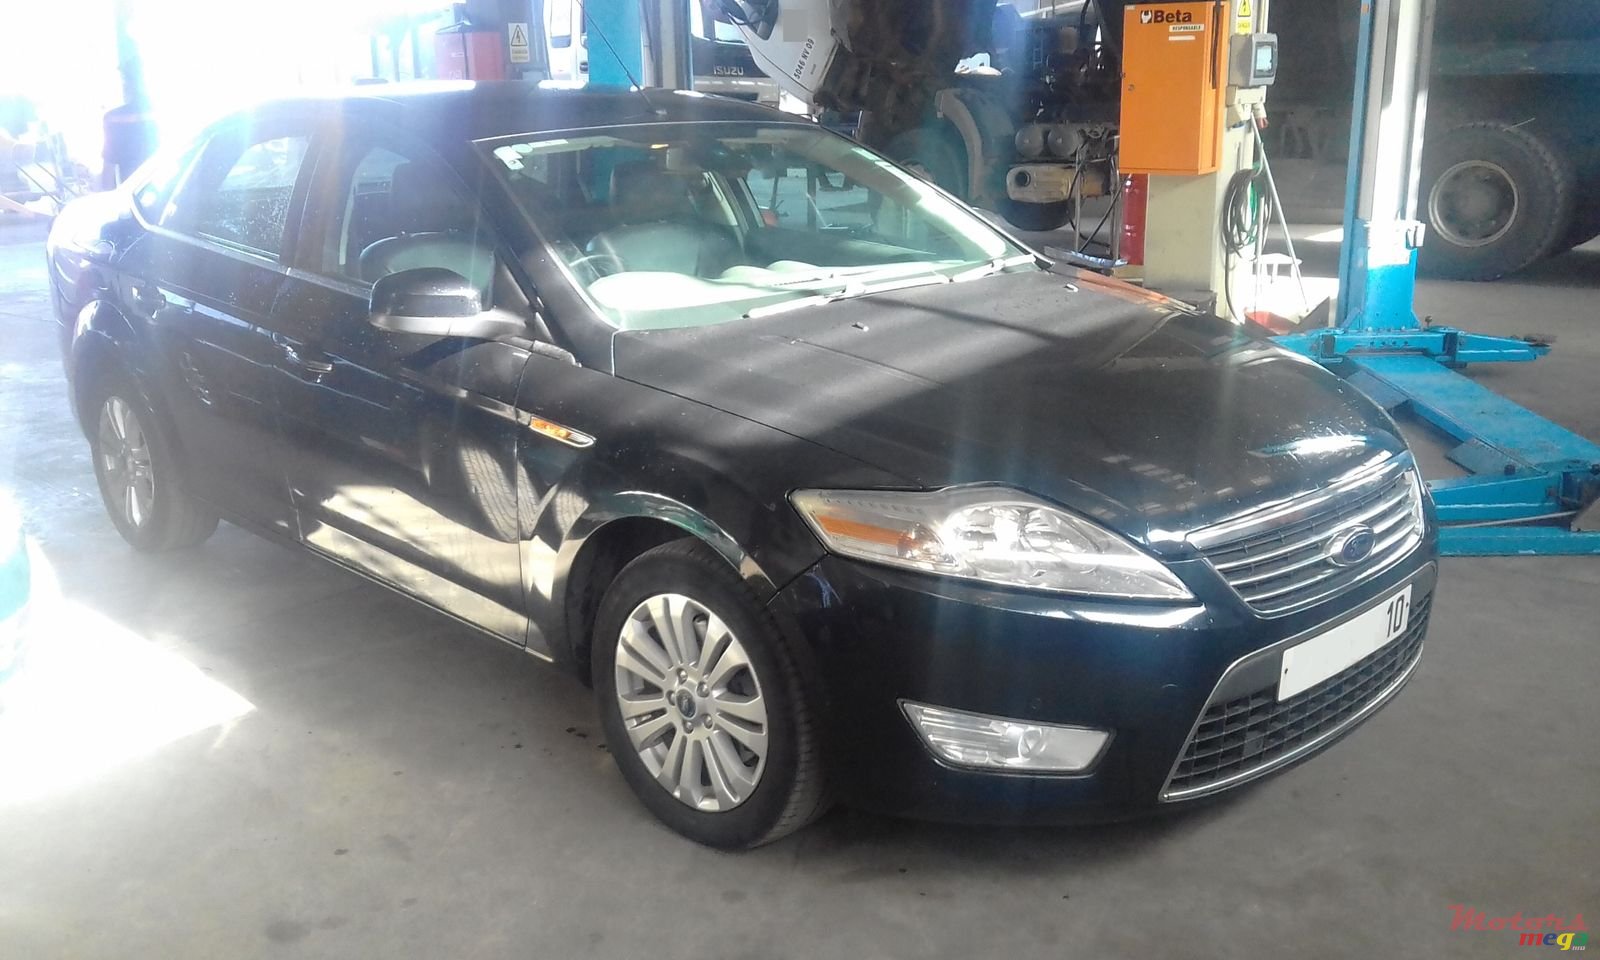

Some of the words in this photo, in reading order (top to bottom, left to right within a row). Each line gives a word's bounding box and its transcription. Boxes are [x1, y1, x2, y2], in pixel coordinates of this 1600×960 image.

[1153, 10, 1192, 23] Beta
[713, 65, 744, 76] ISUZU
[793, 59, 806, 80] 5046
[805, 38, 815, 49] 09
[1387, 594, 1405, 638] 10
